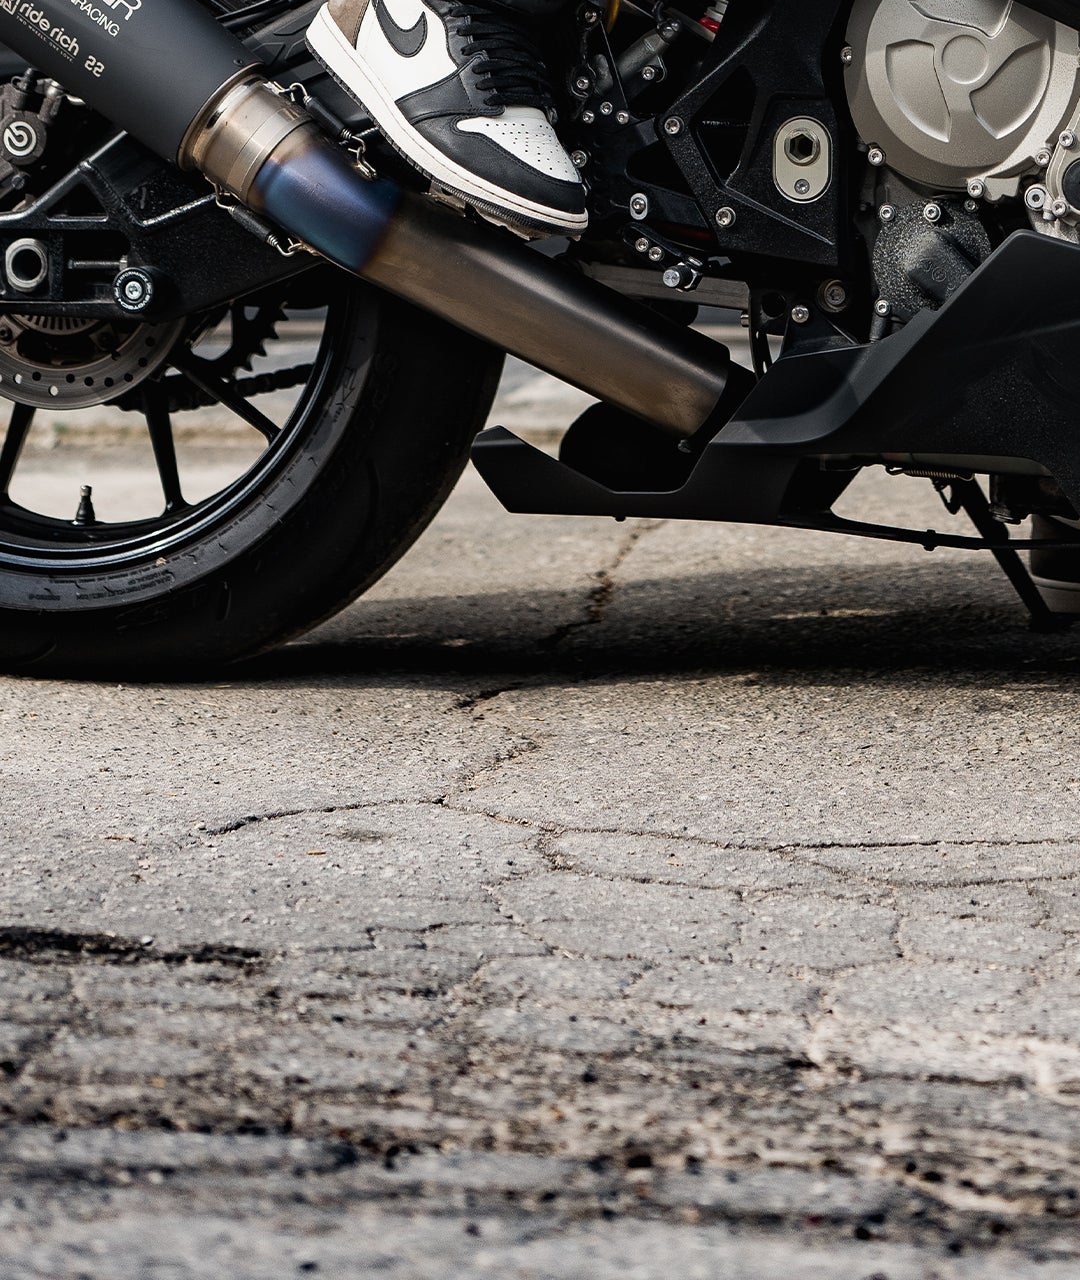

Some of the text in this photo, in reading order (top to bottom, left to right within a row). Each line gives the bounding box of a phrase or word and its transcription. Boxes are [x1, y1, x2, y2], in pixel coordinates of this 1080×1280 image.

[20, 2, 80, 56] ride rich
[84, 55, 105, 77] 22
